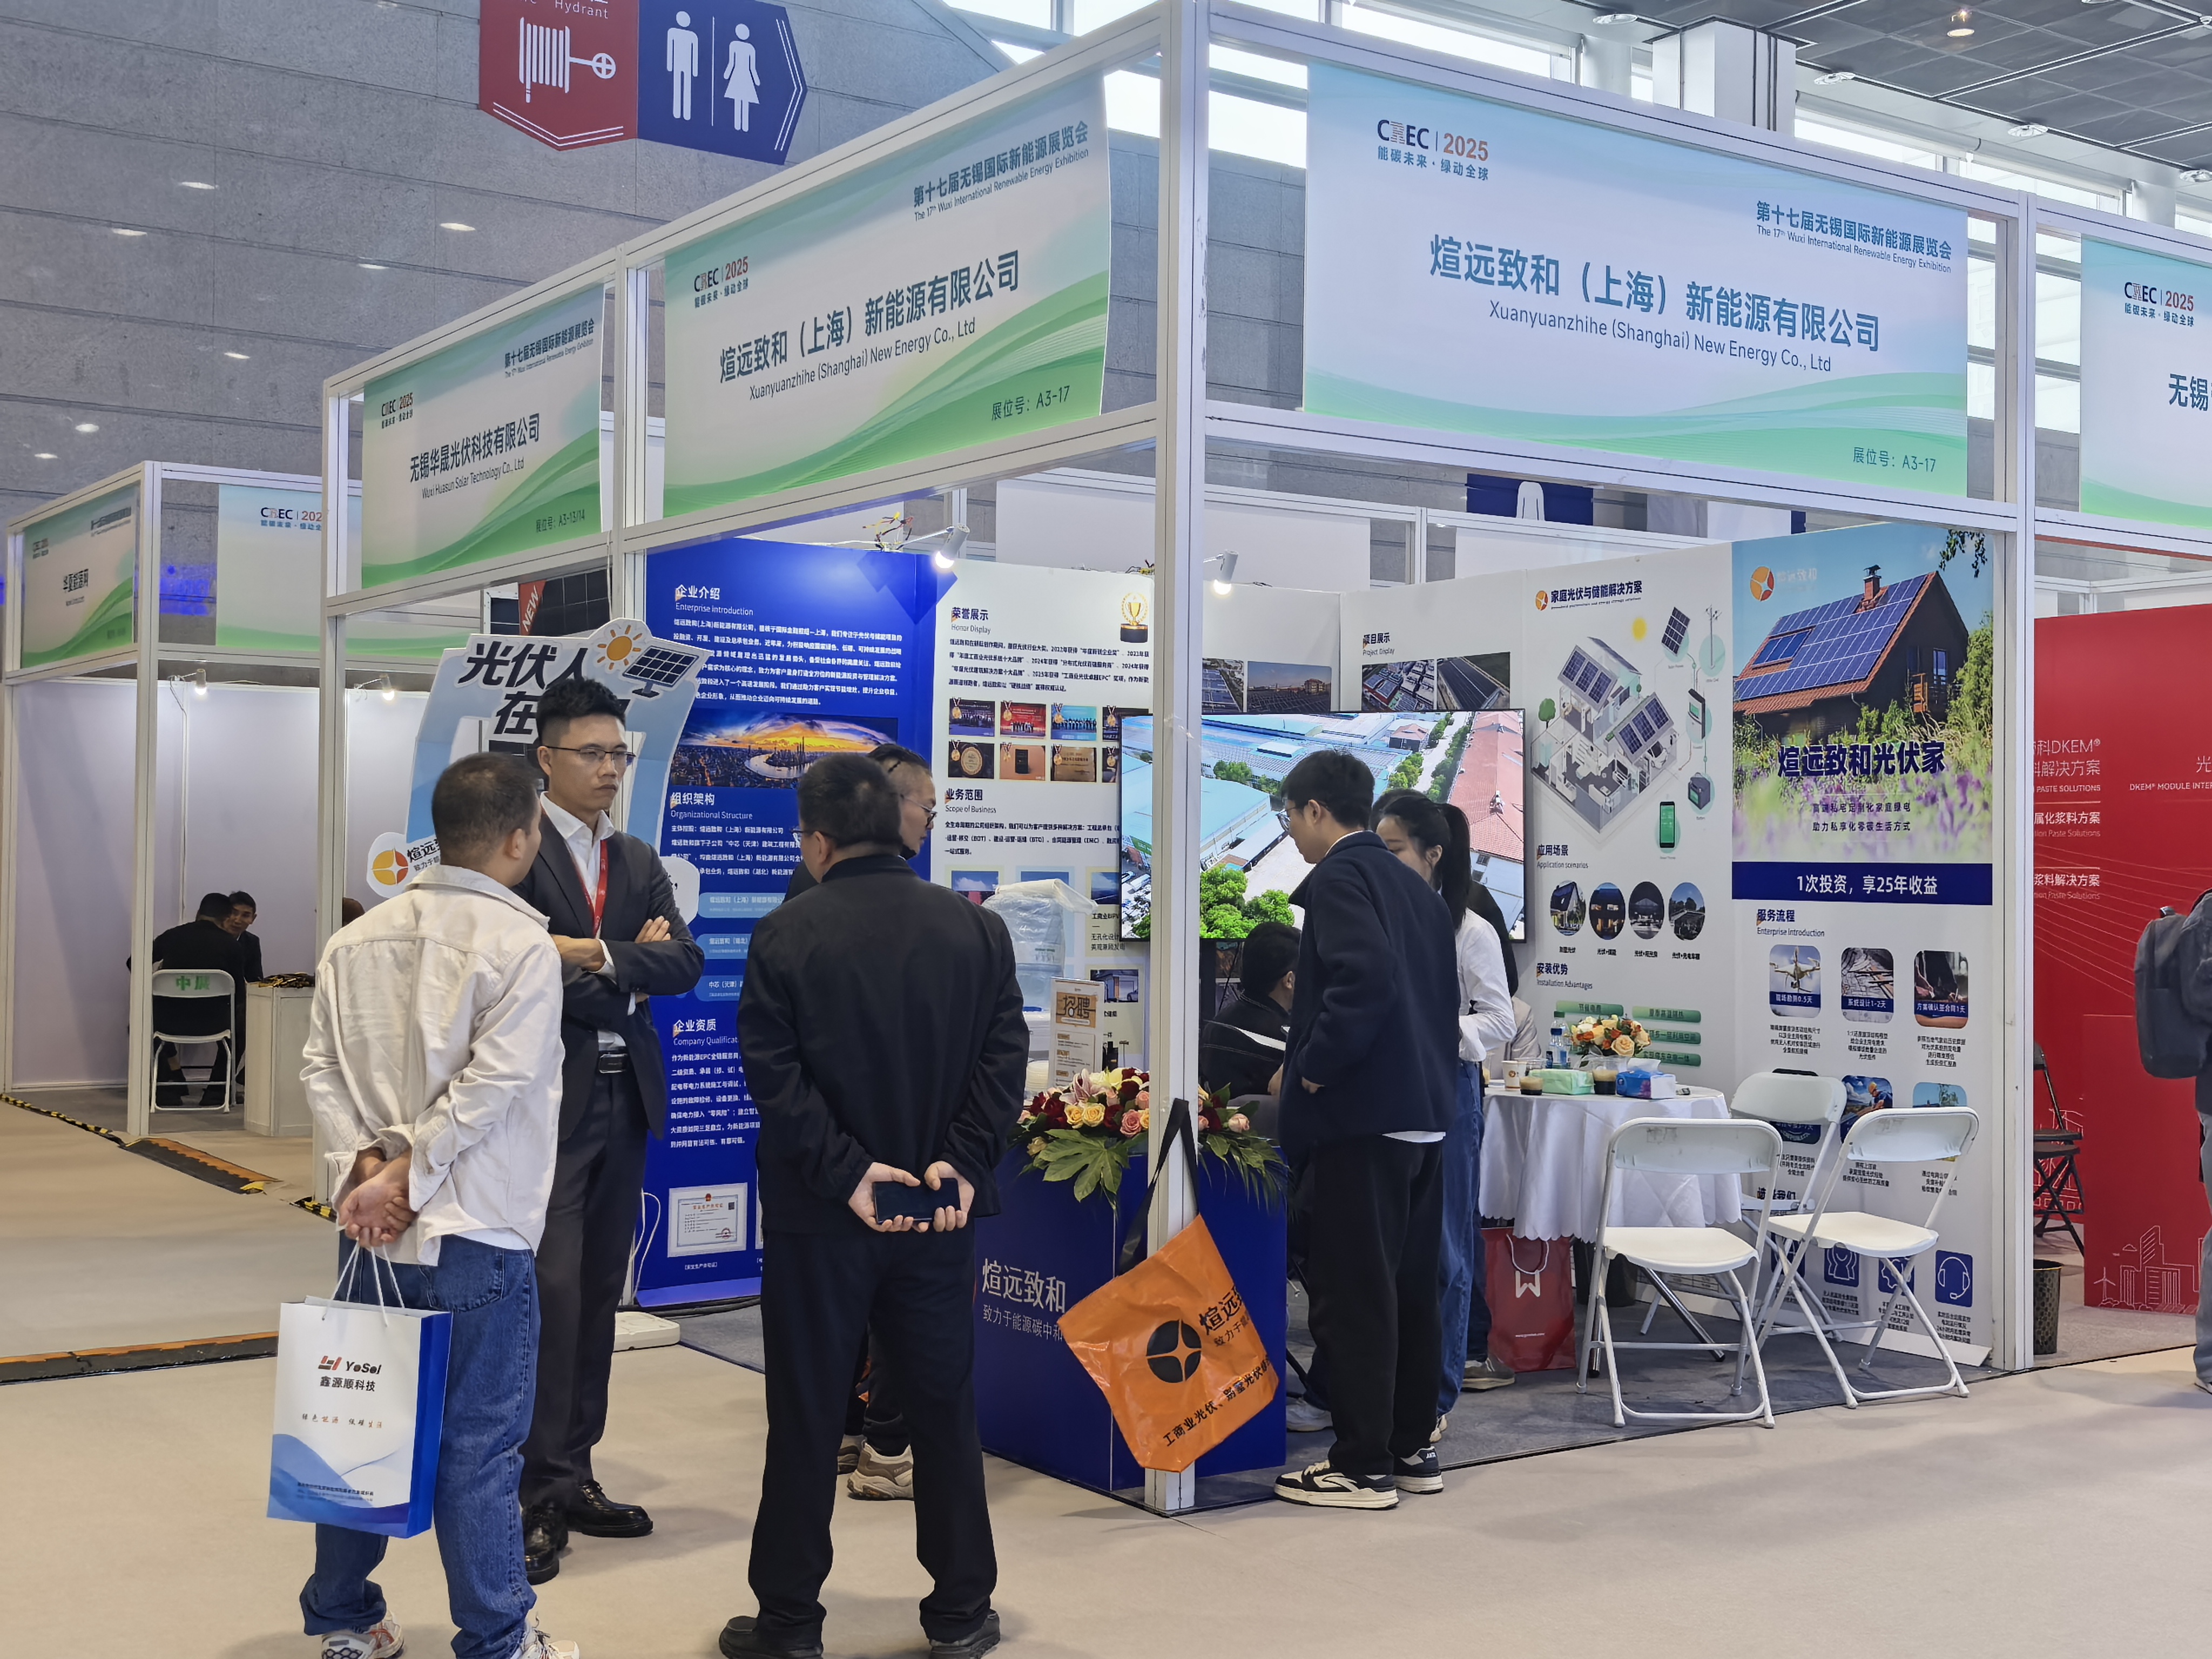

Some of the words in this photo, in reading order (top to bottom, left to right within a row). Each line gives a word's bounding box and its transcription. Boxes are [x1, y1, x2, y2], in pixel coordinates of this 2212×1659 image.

[555, 0, 608, 19] Hydrant
[1444, 133, 1488, 161] 2025
[914, 120, 1089, 208] 第十七届无锡国际新能源展览会
[938, 200, 953, 212] Wuxi
[954, 183, 993, 207] International
[994, 171, 1028, 191] Renewable
[1030, 163, 1053, 178] Energy
[1055, 149, 1089, 168] Exhibition
[1757, 200, 1952, 260] 第十七届无锡国际新能源展览会
[1757, 225, 1771, 237] The
[1787, 231, 1805, 243] Wuxi
[1808, 237, 1852, 253] International
[1854, 245, 1891, 261] Renewable
[1893, 253, 1917, 268] Energy
[1919, 259, 1952, 273] Exhibition
[725, 256, 748, 281] 2025
[1429, 233, 1880, 352] 煊远致和（上海）新能源有限公司
[2165, 290, 2194, 312] 2025
[720, 249, 1019, 384] 煊远致和（上海）新能源有限公司
[1489, 299, 1607, 339] Xuanyuanzhihe
[1612, 315, 1691, 353] (Shanghai)
[1694, 335, 1725, 357] New
[1729, 339, 1777, 372] Energy
[1781, 348, 1806, 373] Co.,
[1810, 353, 1832, 373] Ltd
[749, 368, 815, 401] Xuanyuanzhihe
[818, 347, 868, 382] (Shanghai)
[870, 344, 893, 364] New
[895, 331, 932, 360] Energy
[934, 325, 955, 347] Co.,
[957, 318, 975, 338] Ltd
[2169, 373, 2212, 412] 无锡
[410, 413, 540, 483] 无锡华晟光伏科技有限公司
[422, 486, 435, 498] Wuxi
[435, 480, 454, 496] Huasun
[455, 476, 469, 489] Solar
[470, 466, 502, 484] Technology
[515, 456, 524, 470] Ltd
[301, 510, 322, 522] 202
[676, 584, 720, 600] 企业介绍
[1551, 580, 1642, 603] 家庭光伏与储能解决方案
[676, 603, 710, 613] Enterprise
[952, 606, 989, 621] 荣誉展示
[970, 624, 991, 635] Display
[1363, 632, 1390, 645] 项目展示
[457, 641, 589, 689] 光伏人
[1777, 740, 1945, 778] 煊远致和光伏家
[671, 792, 714, 805] 组织架构
[946, 788, 982, 800] 业务范围
[671, 810, 720, 820] Organizational
[721, 811, 753, 820] Structure
[945, 805, 963, 813] Scope
[972, 805, 996, 813] Business
[1537, 844, 1568, 857] 应用场景
[1537, 861, 1563, 869] Application
[1797, 874, 1938, 895] 1次投资，享25年收益
[1757, 908, 1795, 922] 服务流程
[1757, 927, 1787, 937] Enterprise
[1537, 963, 1568, 975] 安装优势
[176, 975, 210, 991] 中展
[673, 1019, 717, 1032] 企业资质
[673, 1037, 704, 1046] Company
[706, 1035, 739, 1045] Qualificat
[982, 1258, 1066, 1313] 煊远致和
[320, 1375, 376, 1392] 鑫源顺科技
